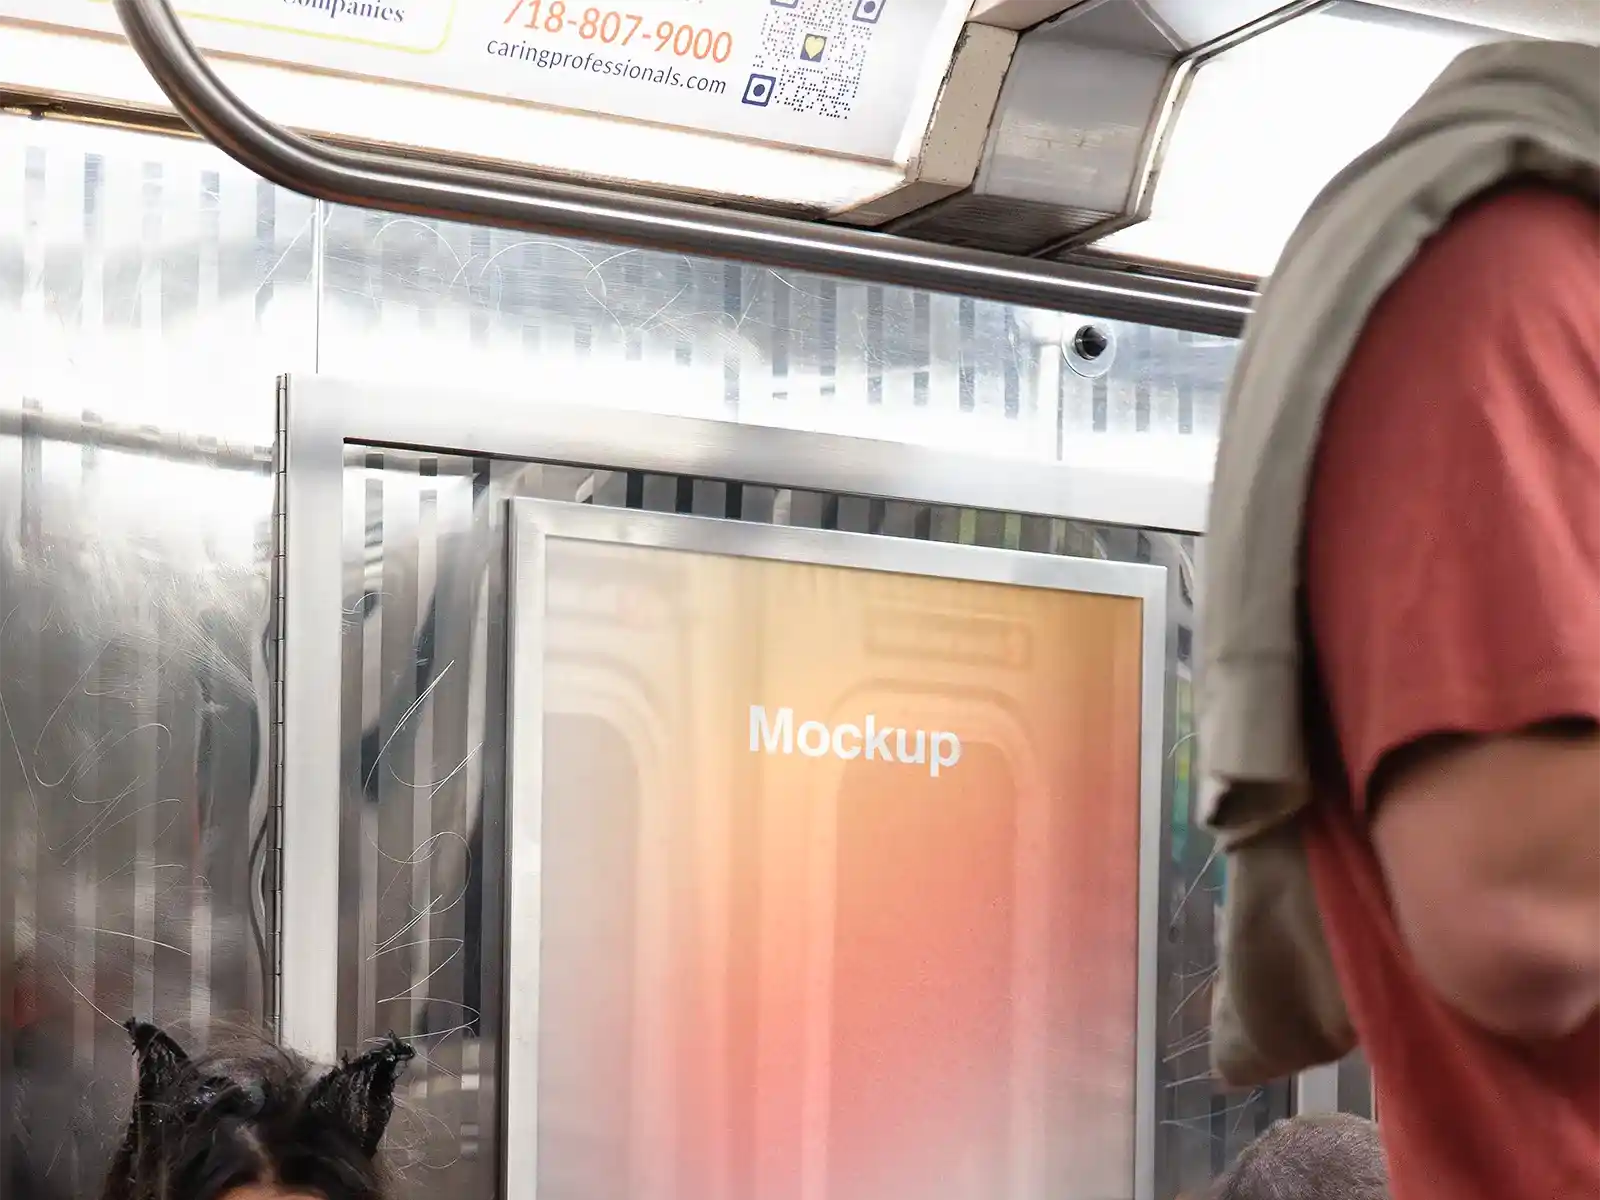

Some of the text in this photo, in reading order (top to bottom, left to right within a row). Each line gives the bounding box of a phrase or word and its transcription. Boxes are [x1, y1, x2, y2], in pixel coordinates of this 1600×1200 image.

[283, 0, 405, 22] ompanies
[487, 40, 726, 94] caringprofessionals.com
[749, 704, 961, 777] Mockup
